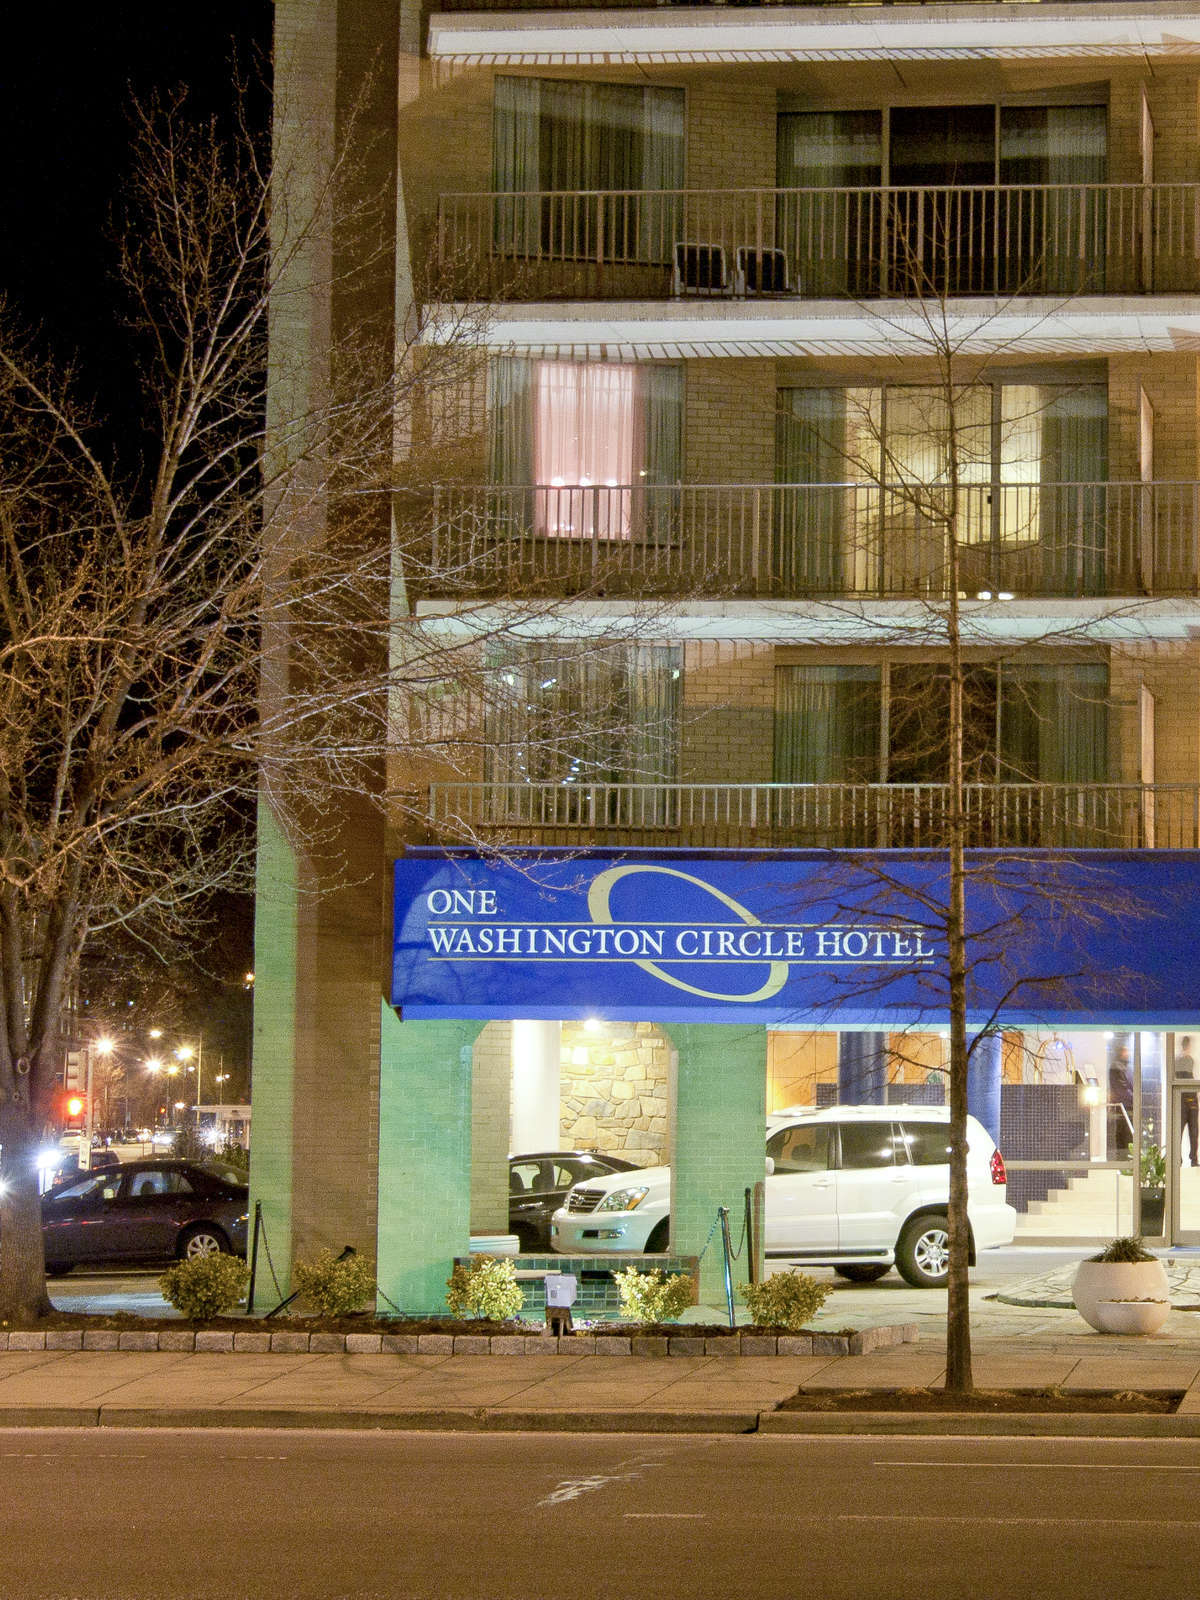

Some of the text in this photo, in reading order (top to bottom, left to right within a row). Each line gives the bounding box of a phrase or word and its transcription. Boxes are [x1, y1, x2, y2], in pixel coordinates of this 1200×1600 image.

[427, 888, 497, 915] ONE
[427, 927, 934, 957] WASHINGTON CIRCLE HOTEL
